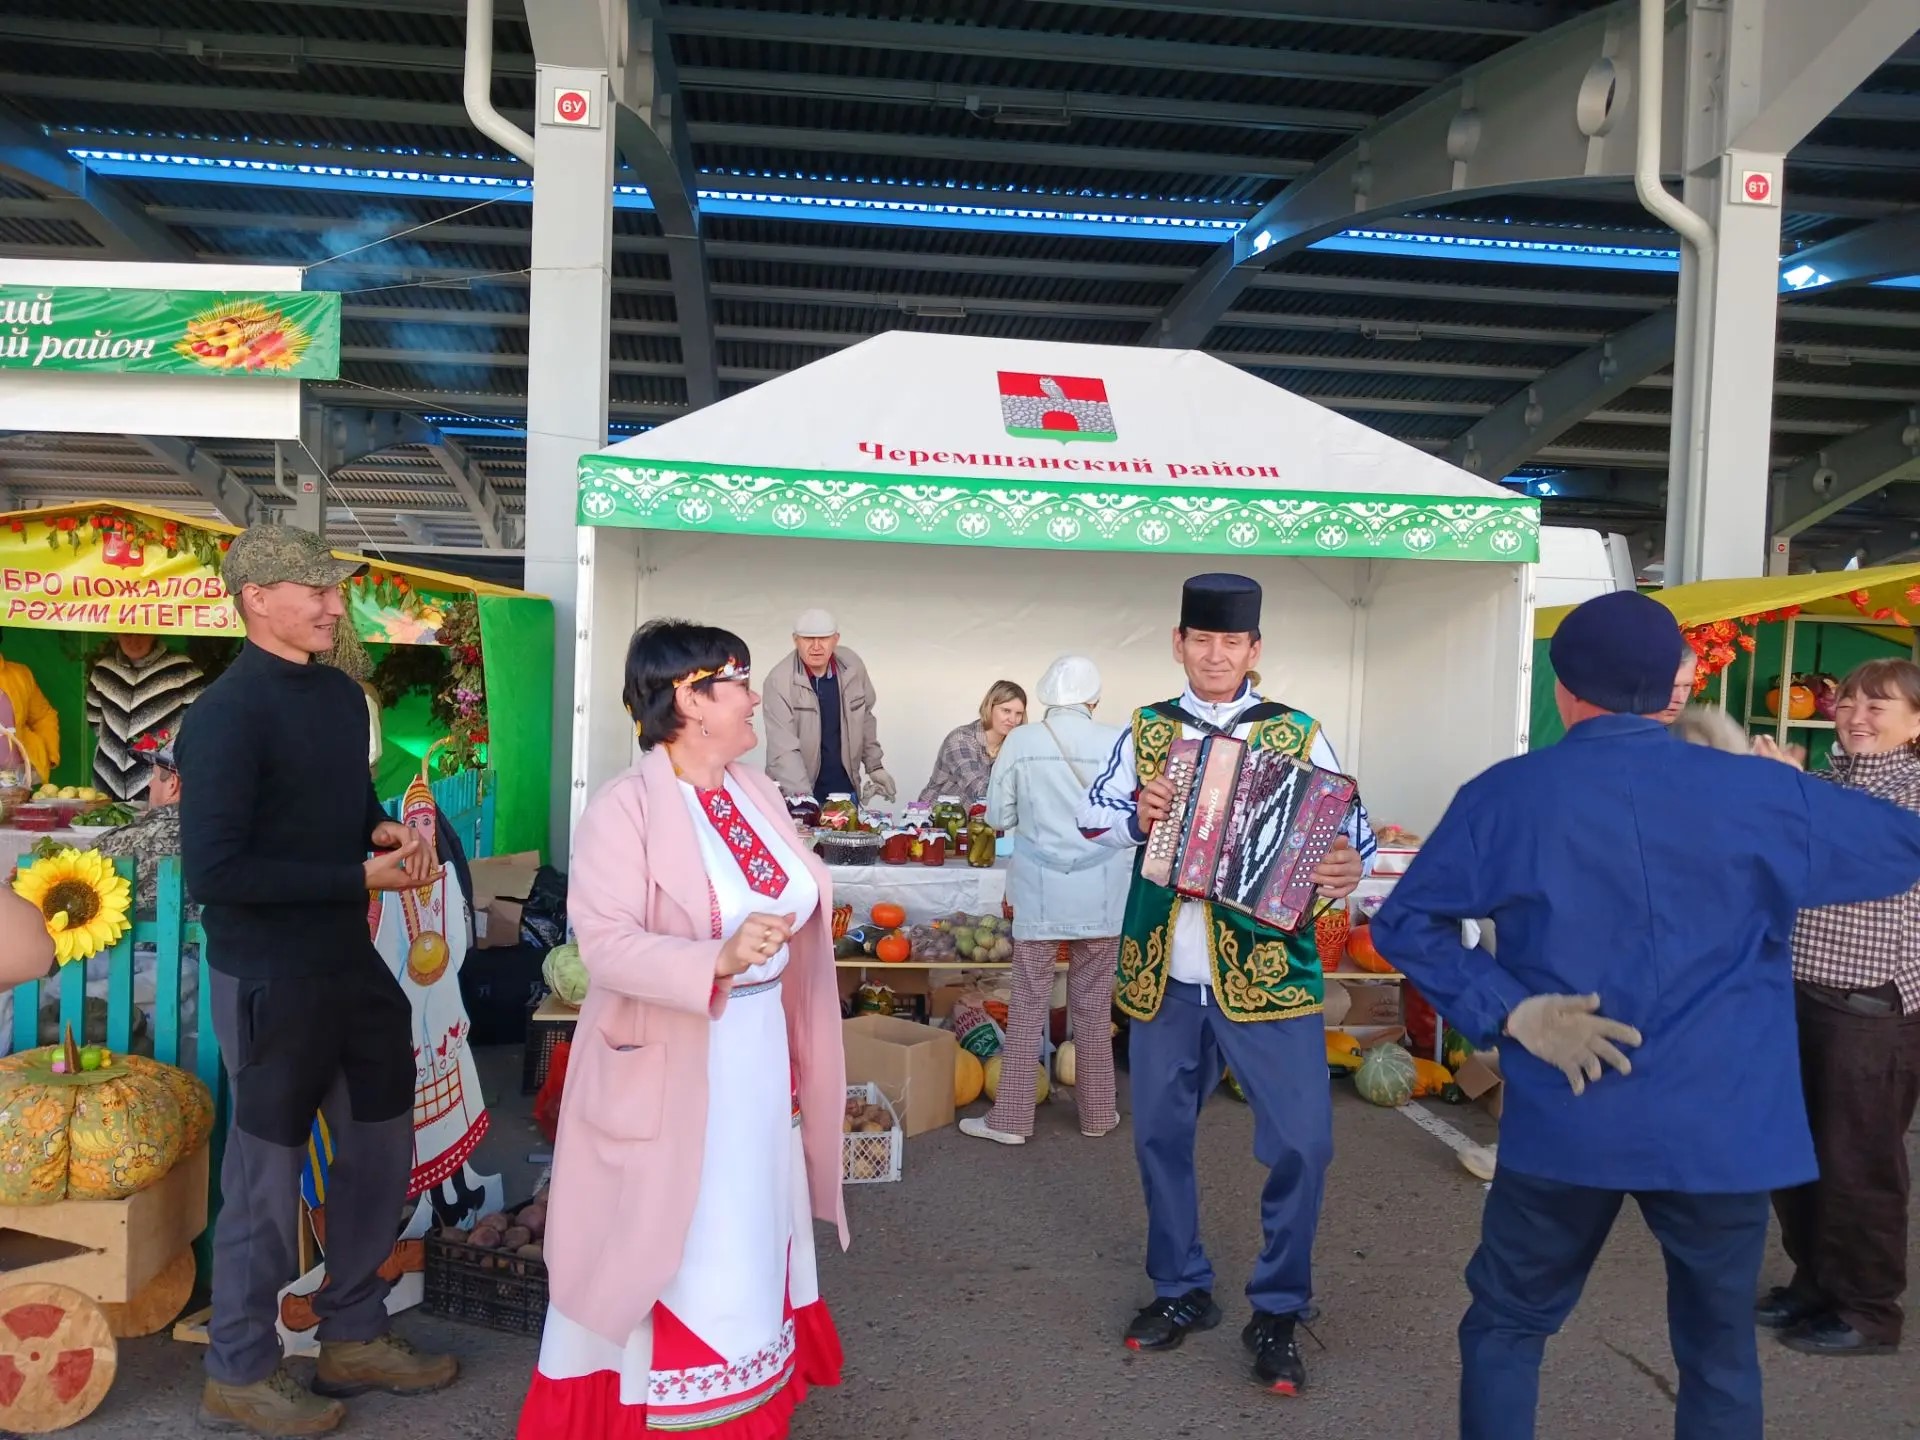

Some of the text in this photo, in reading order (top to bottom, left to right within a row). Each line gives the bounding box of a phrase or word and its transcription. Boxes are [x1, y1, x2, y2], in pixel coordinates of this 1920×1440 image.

[34, 330, 156, 367] район
[857, 442, 1281, 479] Черемшанский район
[0, 569, 62, 596] БРО
[119, 604, 238, 629] ИТЕГЕЗ!
